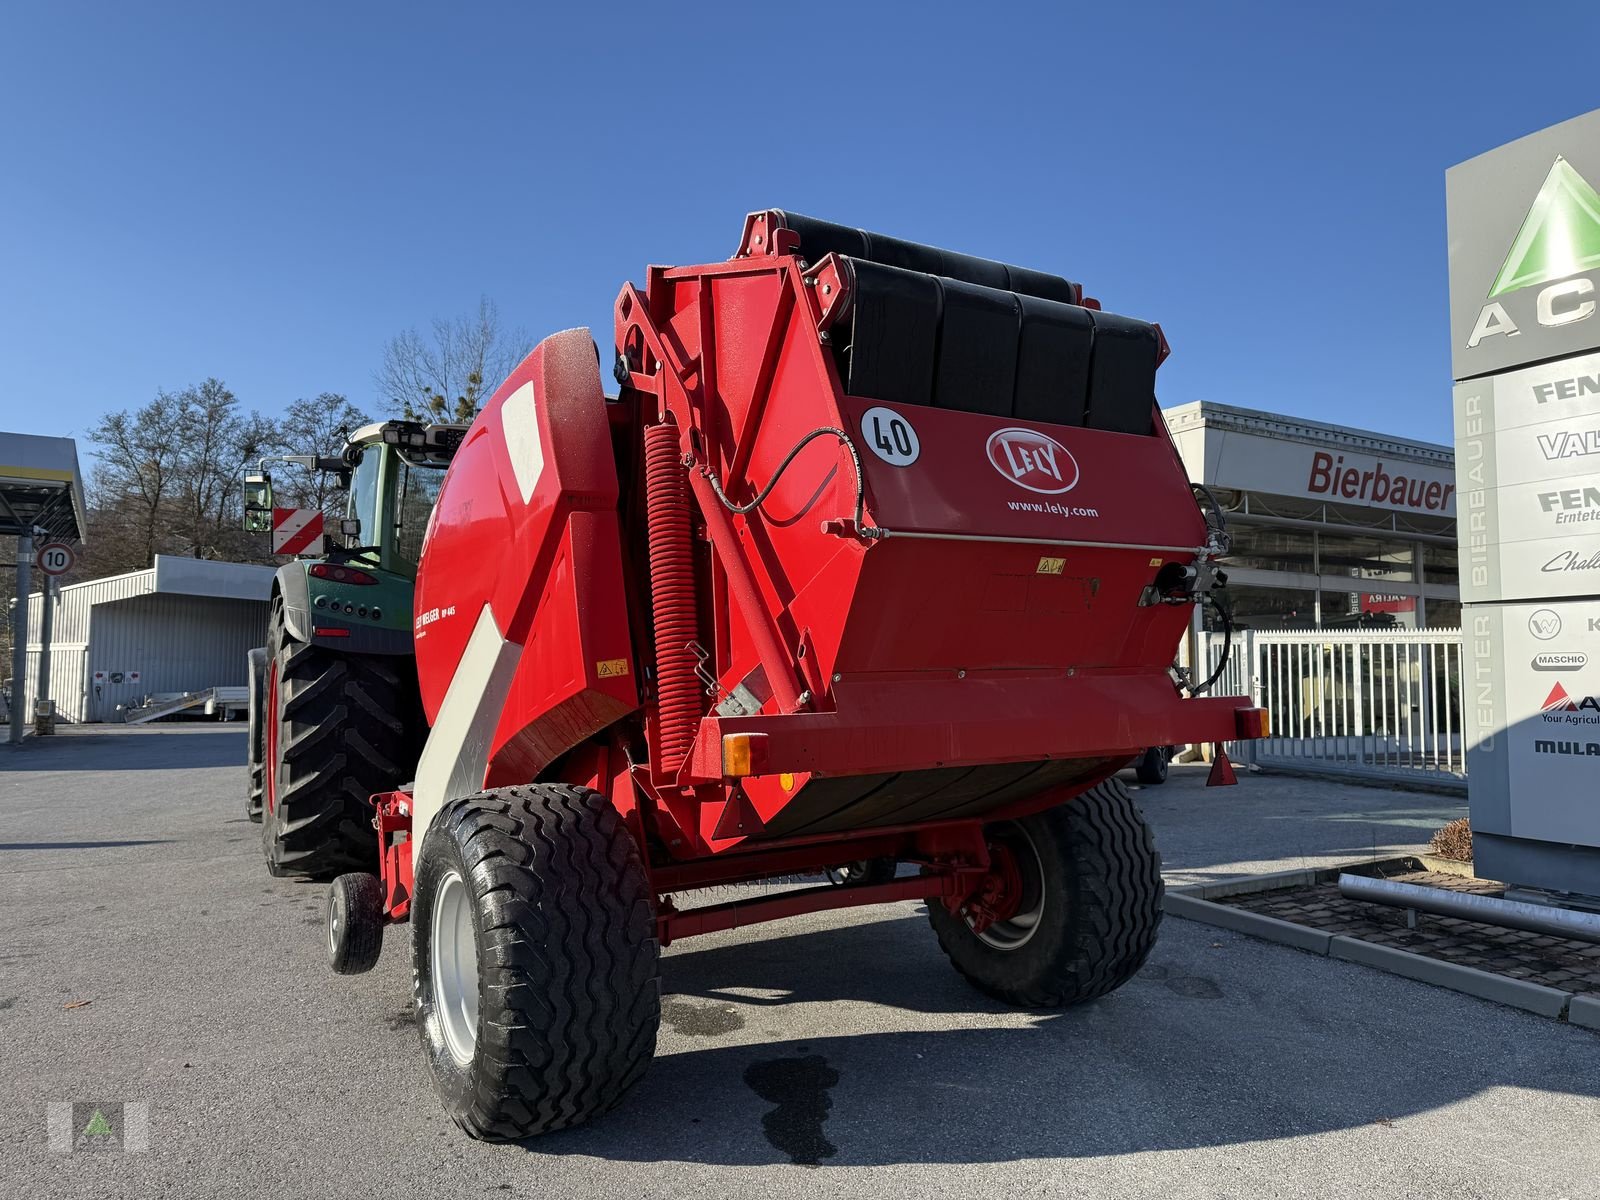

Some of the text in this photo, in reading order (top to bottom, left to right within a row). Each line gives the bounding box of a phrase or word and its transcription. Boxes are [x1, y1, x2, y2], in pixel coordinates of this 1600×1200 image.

[872, 416, 913, 457] 40
[1537, 430, 1600, 461] VAL
[1001, 437, 1063, 482] LELY
[1308, 452, 1454, 510] Bierbauer
[1007, 500, 1100, 518] www.lely.com
[47, 552, 64, 567] 10
[1466, 395, 1495, 752] CENTER BIERBAUER
[1538, 655, 1586, 664] MASCHIO
[1542, 713, 1563, 723] Your
